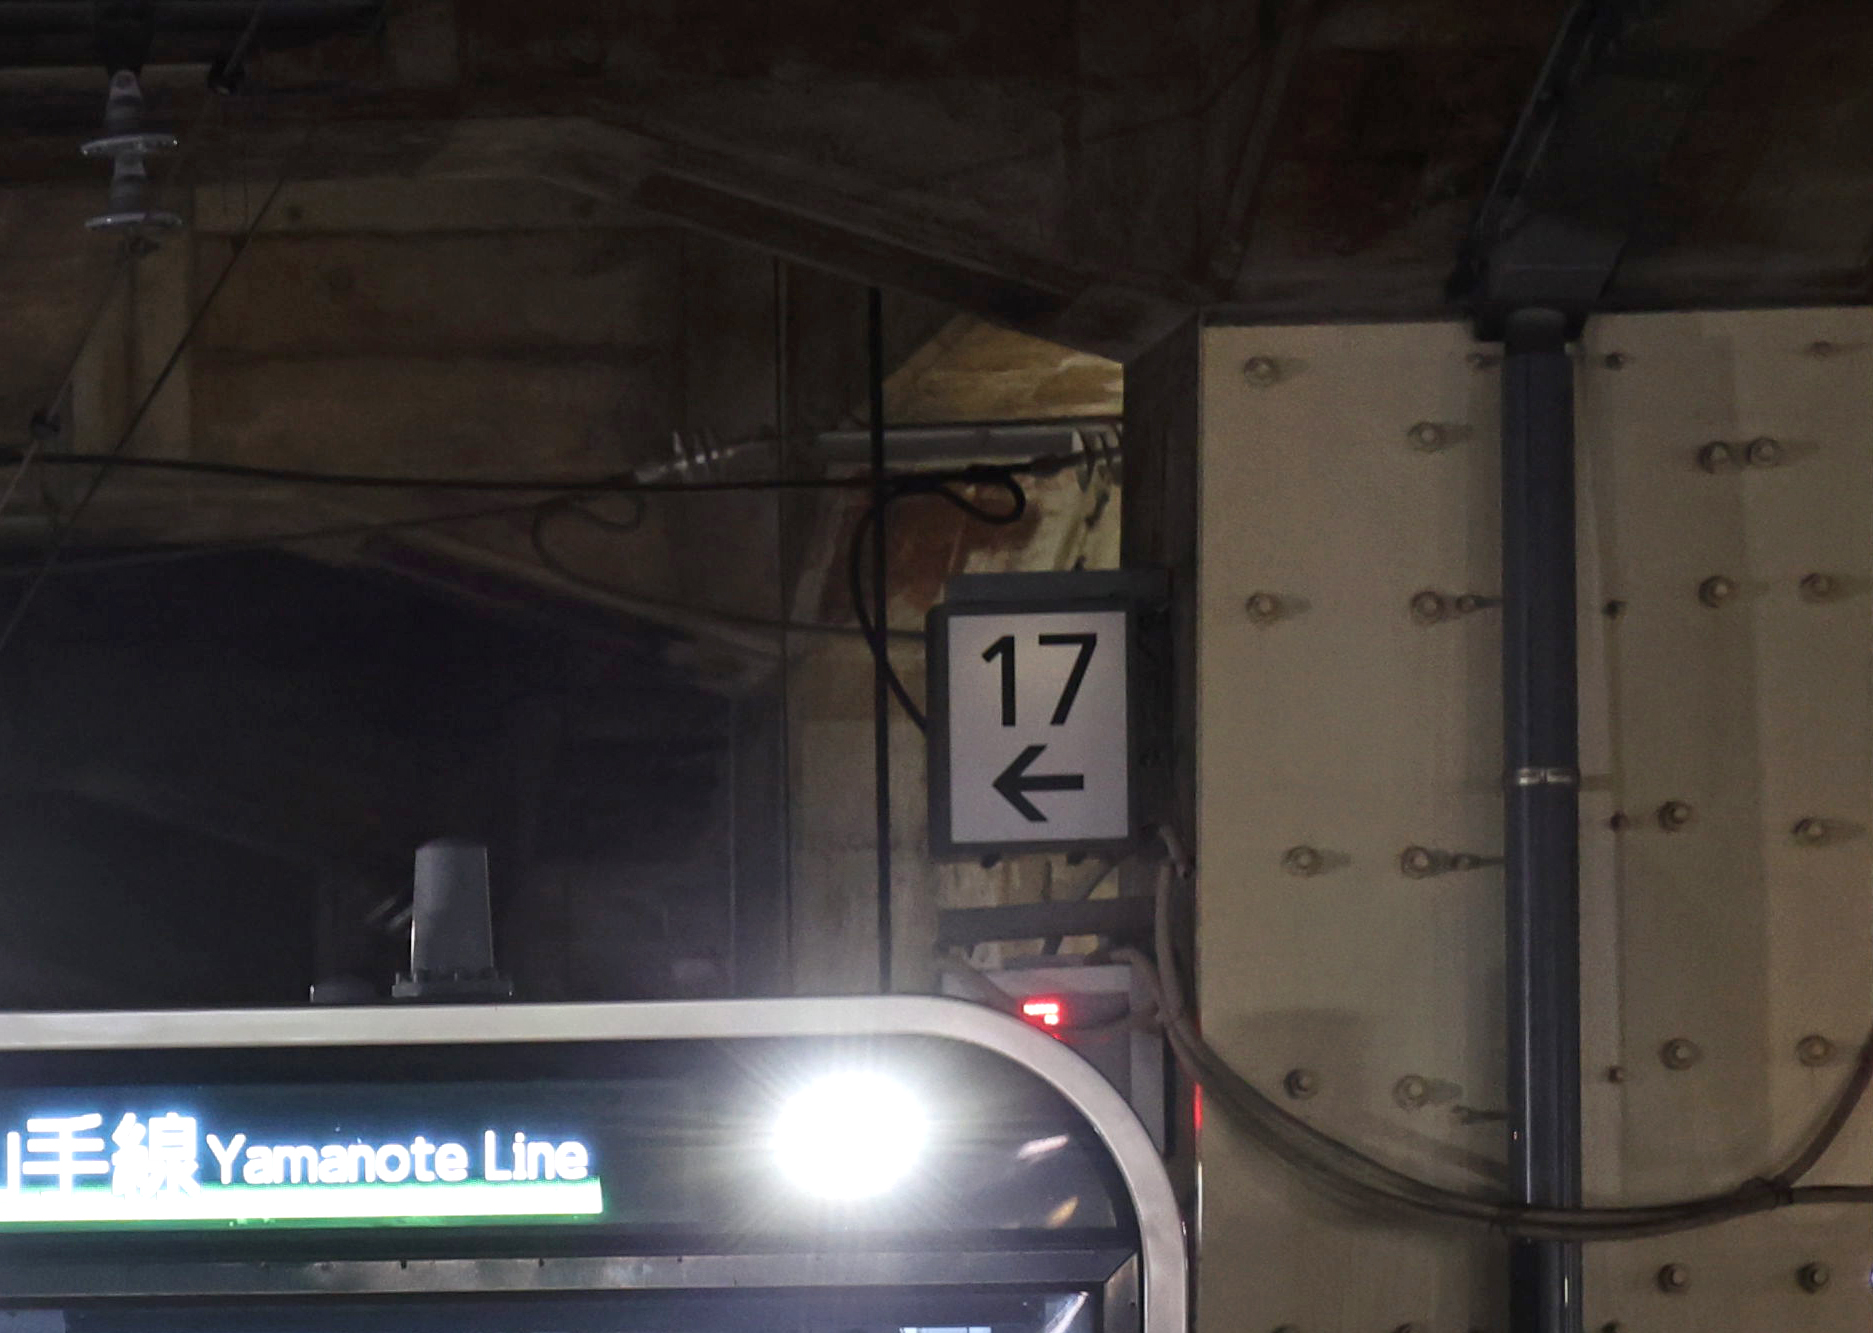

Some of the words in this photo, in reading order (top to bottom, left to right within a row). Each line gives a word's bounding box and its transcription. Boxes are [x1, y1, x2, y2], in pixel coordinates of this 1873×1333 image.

[982, 633, 1097, 727] 17
[206, 1133, 467, 1186] Yamanote
[484, 1130, 588, 1182] Line
